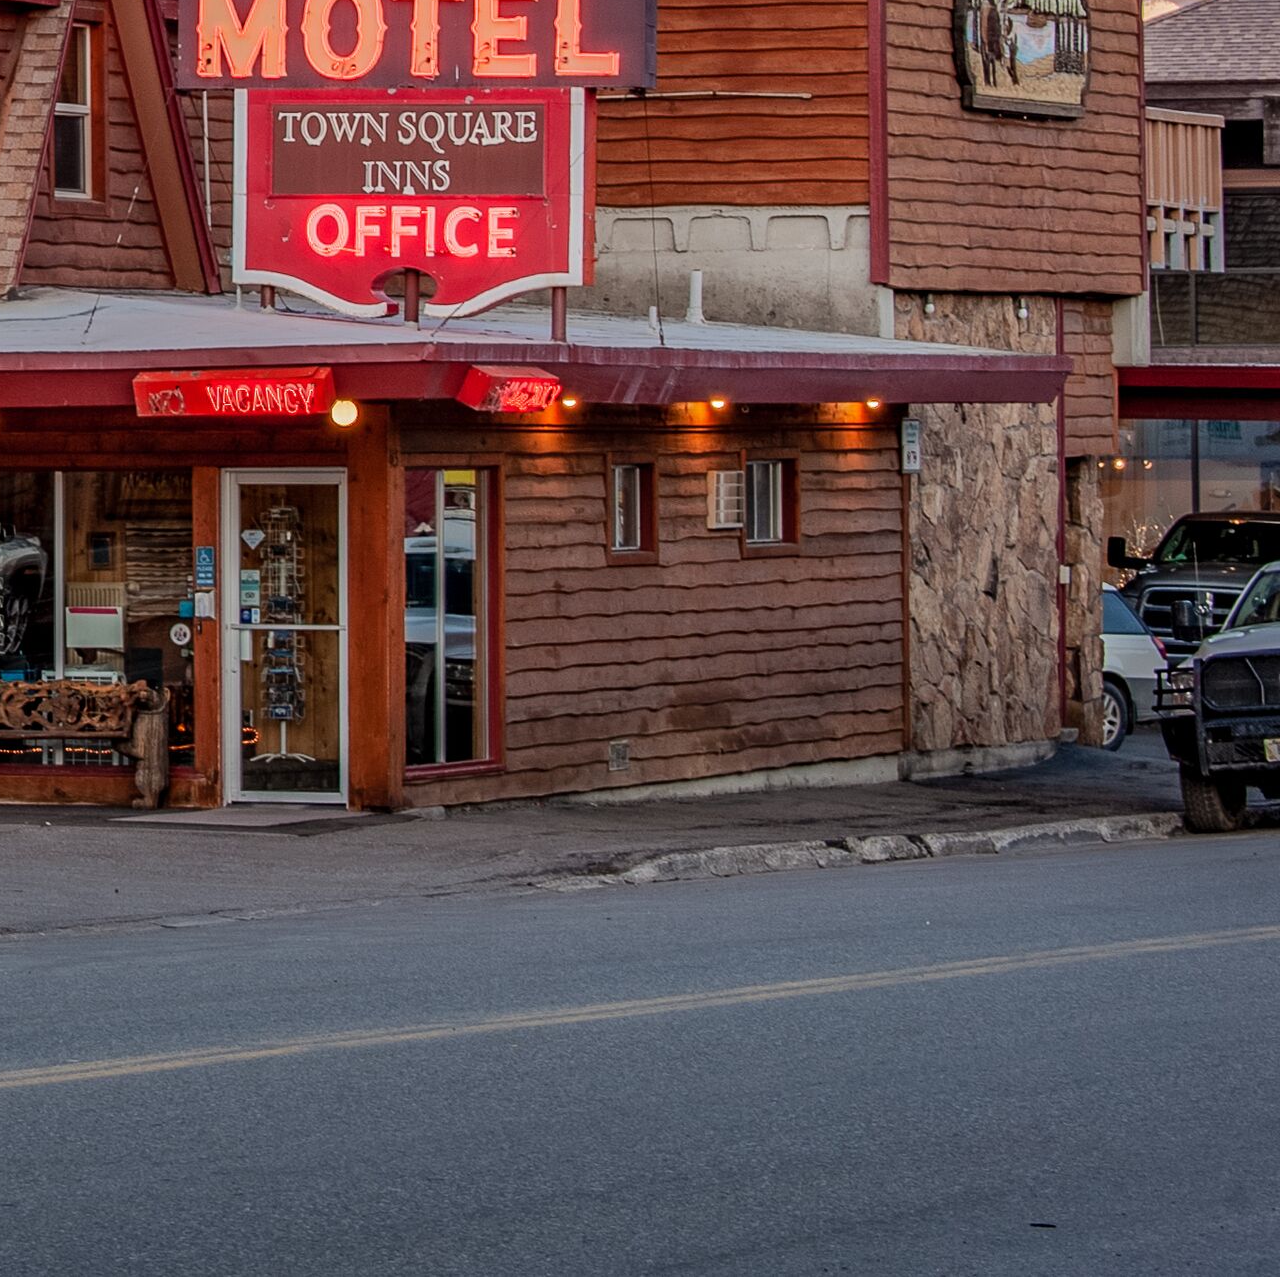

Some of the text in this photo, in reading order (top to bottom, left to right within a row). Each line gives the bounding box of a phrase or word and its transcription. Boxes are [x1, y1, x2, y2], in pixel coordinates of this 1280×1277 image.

[278, 110, 538, 153] TOWN SQUARE
[362, 159, 451, 195] INNS
[306, 203, 520, 258] OFFICE
[206, 383, 315, 414] VACANCY
